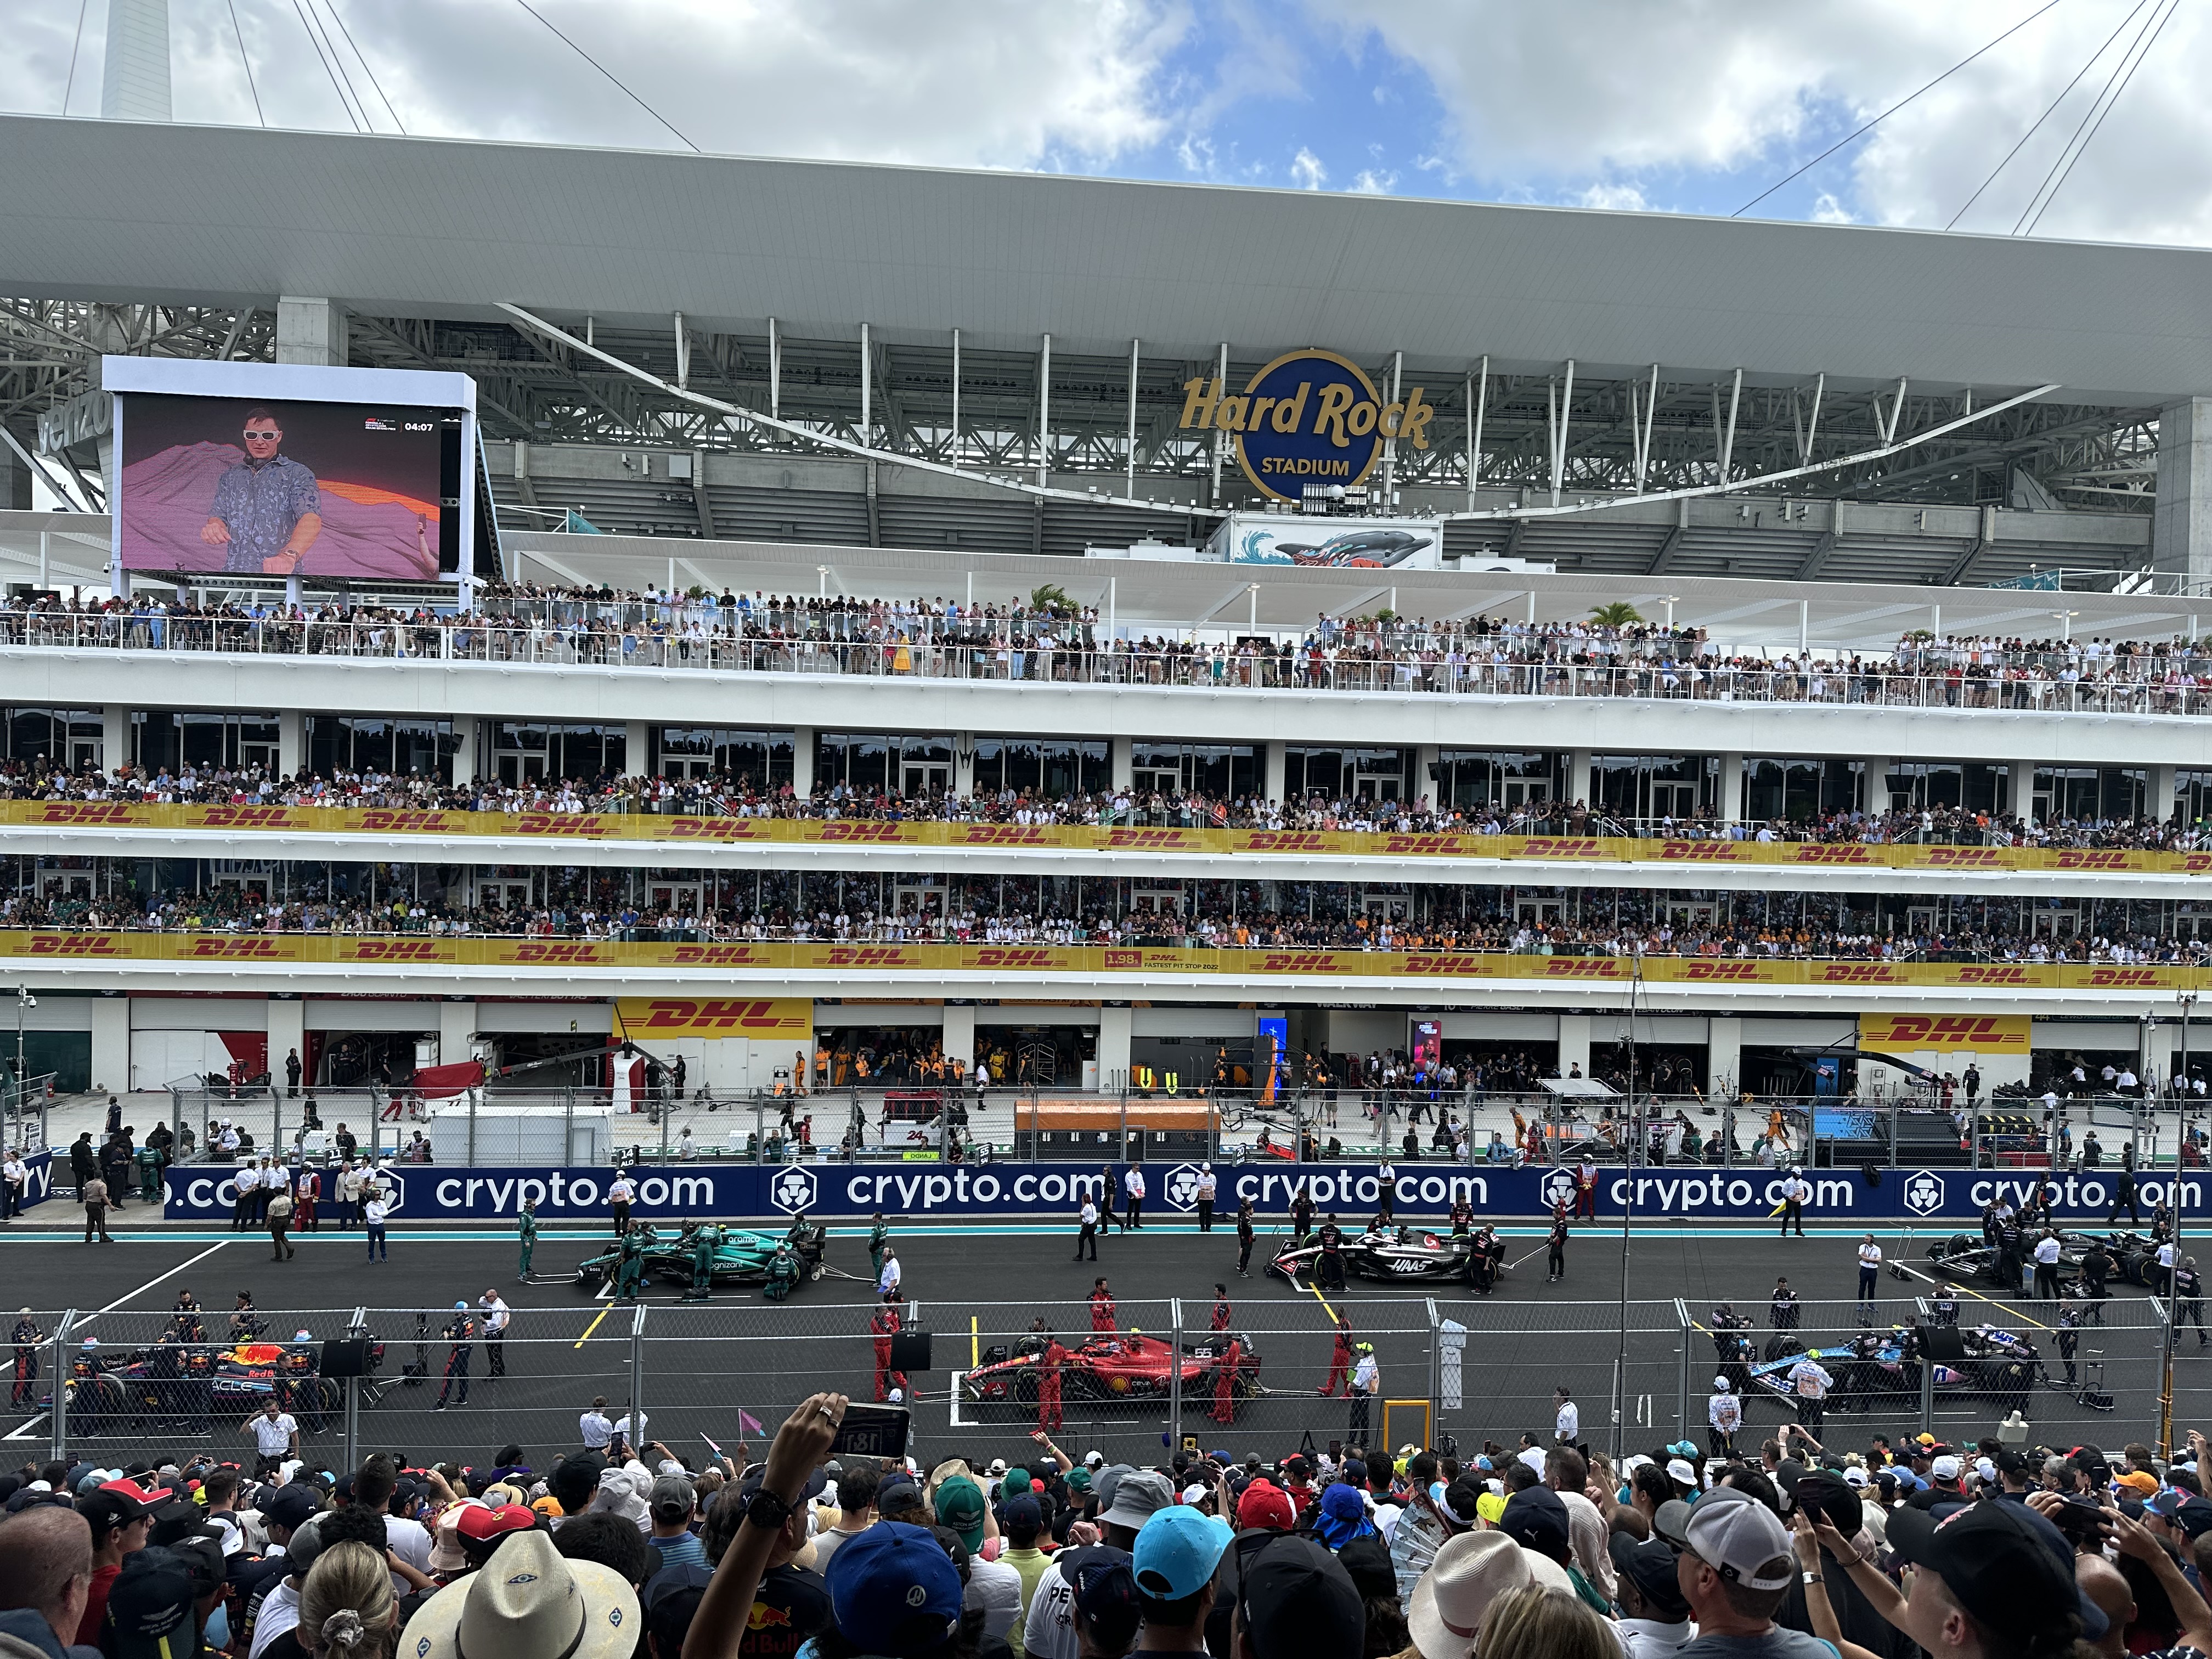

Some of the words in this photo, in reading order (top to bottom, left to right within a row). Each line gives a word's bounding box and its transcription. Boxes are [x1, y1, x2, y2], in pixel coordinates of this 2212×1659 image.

[1179, 377, 1311, 433] Hard
[1313, 382, 1434, 449] Rock
[37, 390, 110, 456] verizo
[405, 422, 433, 431] 04:07
[1262, 457, 1349, 476] STADIUM
[43, 805, 132, 823] DHL
[204, 808, 291, 826] DHL
[362, 812, 449, 830] DHL
[518, 816, 605, 834] DHL
[670, 820, 756, 838] DHL
[820, 824, 904, 841] DHL
[965, 827, 1047, 844] DHL
[1107, 830, 1187, 848] DHL
[1247, 833, 1327, 850] DHL
[1385, 836, 1463, 853] DHL
[1522, 839, 1601, 856] DHL
[1661, 843, 1739, 859] DHL
[1796, 846, 1871, 863] DHL
[1927, 848, 2004, 865] DHL
[2056, 851, 2130, 869] DHL
[30, 936, 116, 953] DHL
[190, 939, 278, 957] DHL
[356, 943, 439, 959] DHL
[515, 944, 599, 962] DHL
[674, 946, 754, 963] DHL
[827, 948, 907, 965] DHL
[977, 950, 1052, 966] DHL
[1108, 953, 1138, 965] 1.98s
[1263, 955, 1338, 970] DHL
[1405, 957, 1480, 973] DHL
[1545, 960, 1621, 977] DHL
[1686, 963, 1760, 979] DHL
[1822, 966, 1894, 982] DHL
[1959, 967, 2028, 983] DHL
[2090, 970, 2158, 985] DHL
[646, 1001, 781, 1027] DHL
[1888, 1017, 2004, 1042] DHL
[907, 1131, 923, 1140] 24
[329, 1149, 342, 1159] 11
[621, 1149, 634, 1159] 14
[980, 1146, 989, 1156] 55
[1237, 1147, 1244, 1156] 20
[620, 1159, 634, 1167] ALO
[23, 1161, 52, 1198] ry
[848, 1169, 1105, 1209] crypto.com
[1236, 1169, 1487, 1208] cryptocom
[1611, 1175, 1853, 1211] crypto.com
[1971, 1176, 2201, 1212] crypto.om
[710, 1261, 743, 1271] ognizant
[1385, 1259, 1433, 1272] HAAS
[1195, 1348, 1212, 1358] 55
[212, 1379, 252, 1391] ACLE
[1049, 1586, 1073, 1604] PE
